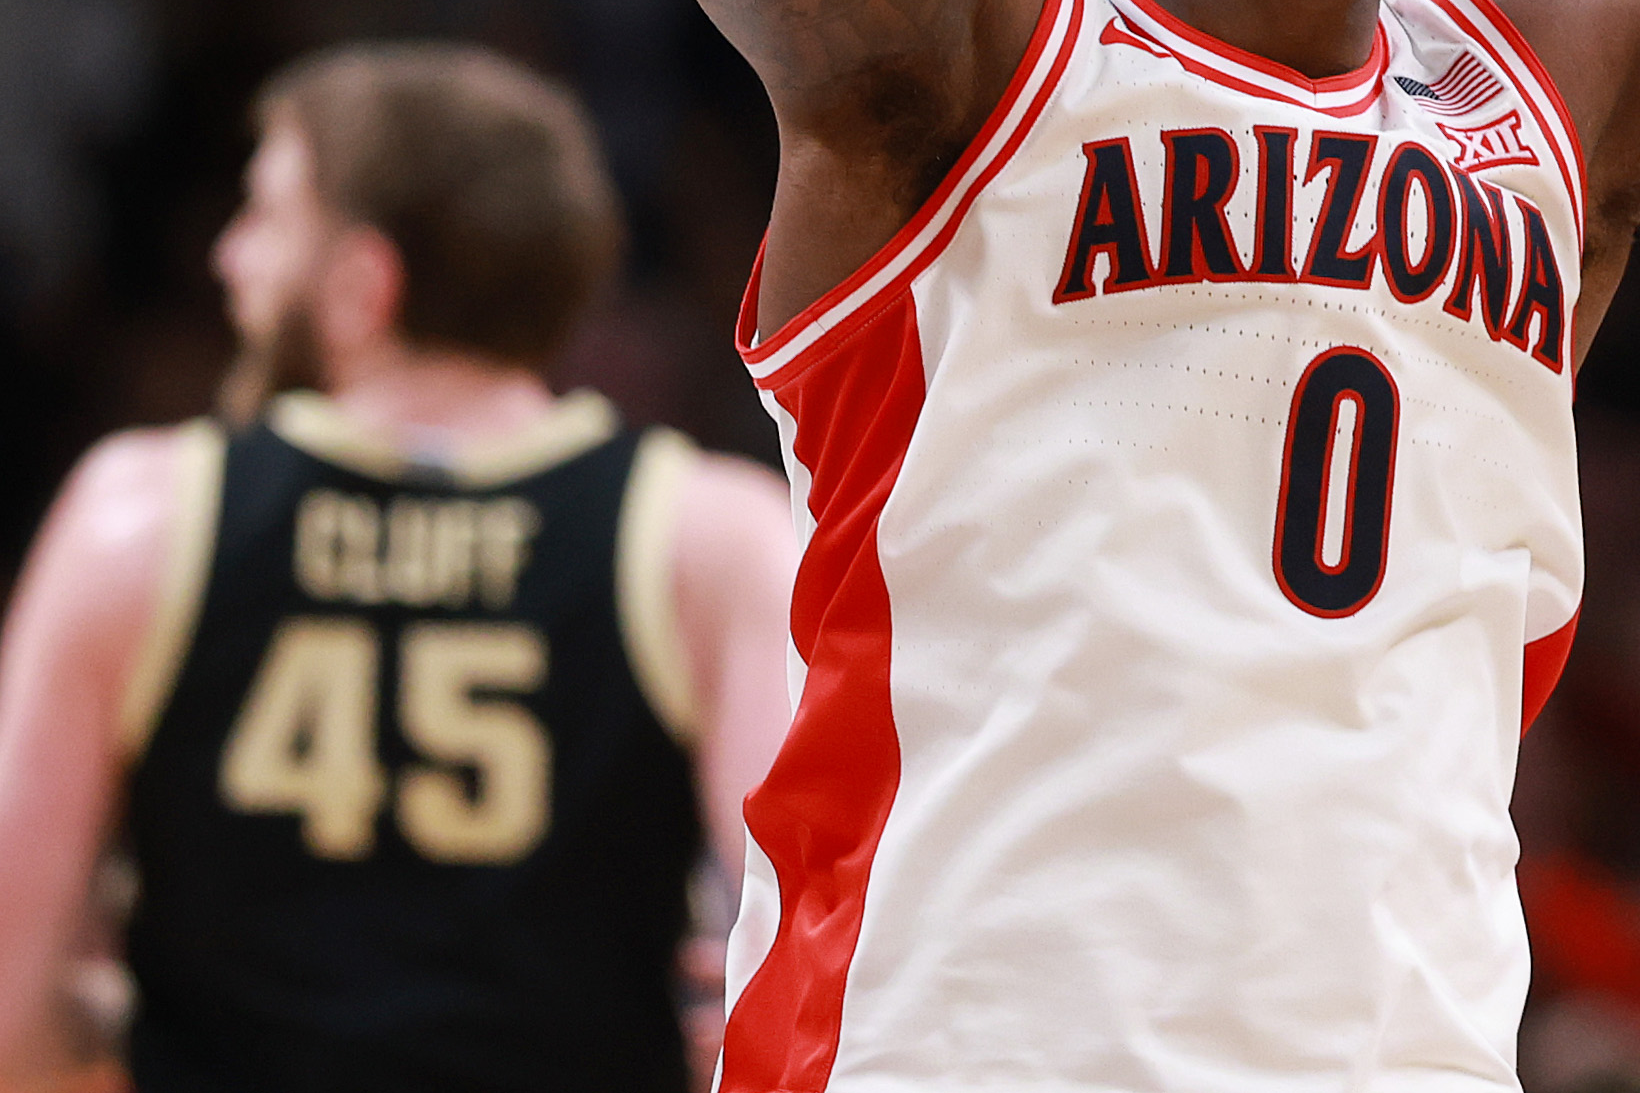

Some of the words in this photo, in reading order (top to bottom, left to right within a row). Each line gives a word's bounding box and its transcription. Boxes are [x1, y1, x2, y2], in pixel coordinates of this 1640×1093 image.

[1053, 126, 1563, 374] ARIZONA
[1273, 345, 1400, 619] 0
[220, 619, 550, 864] 45
